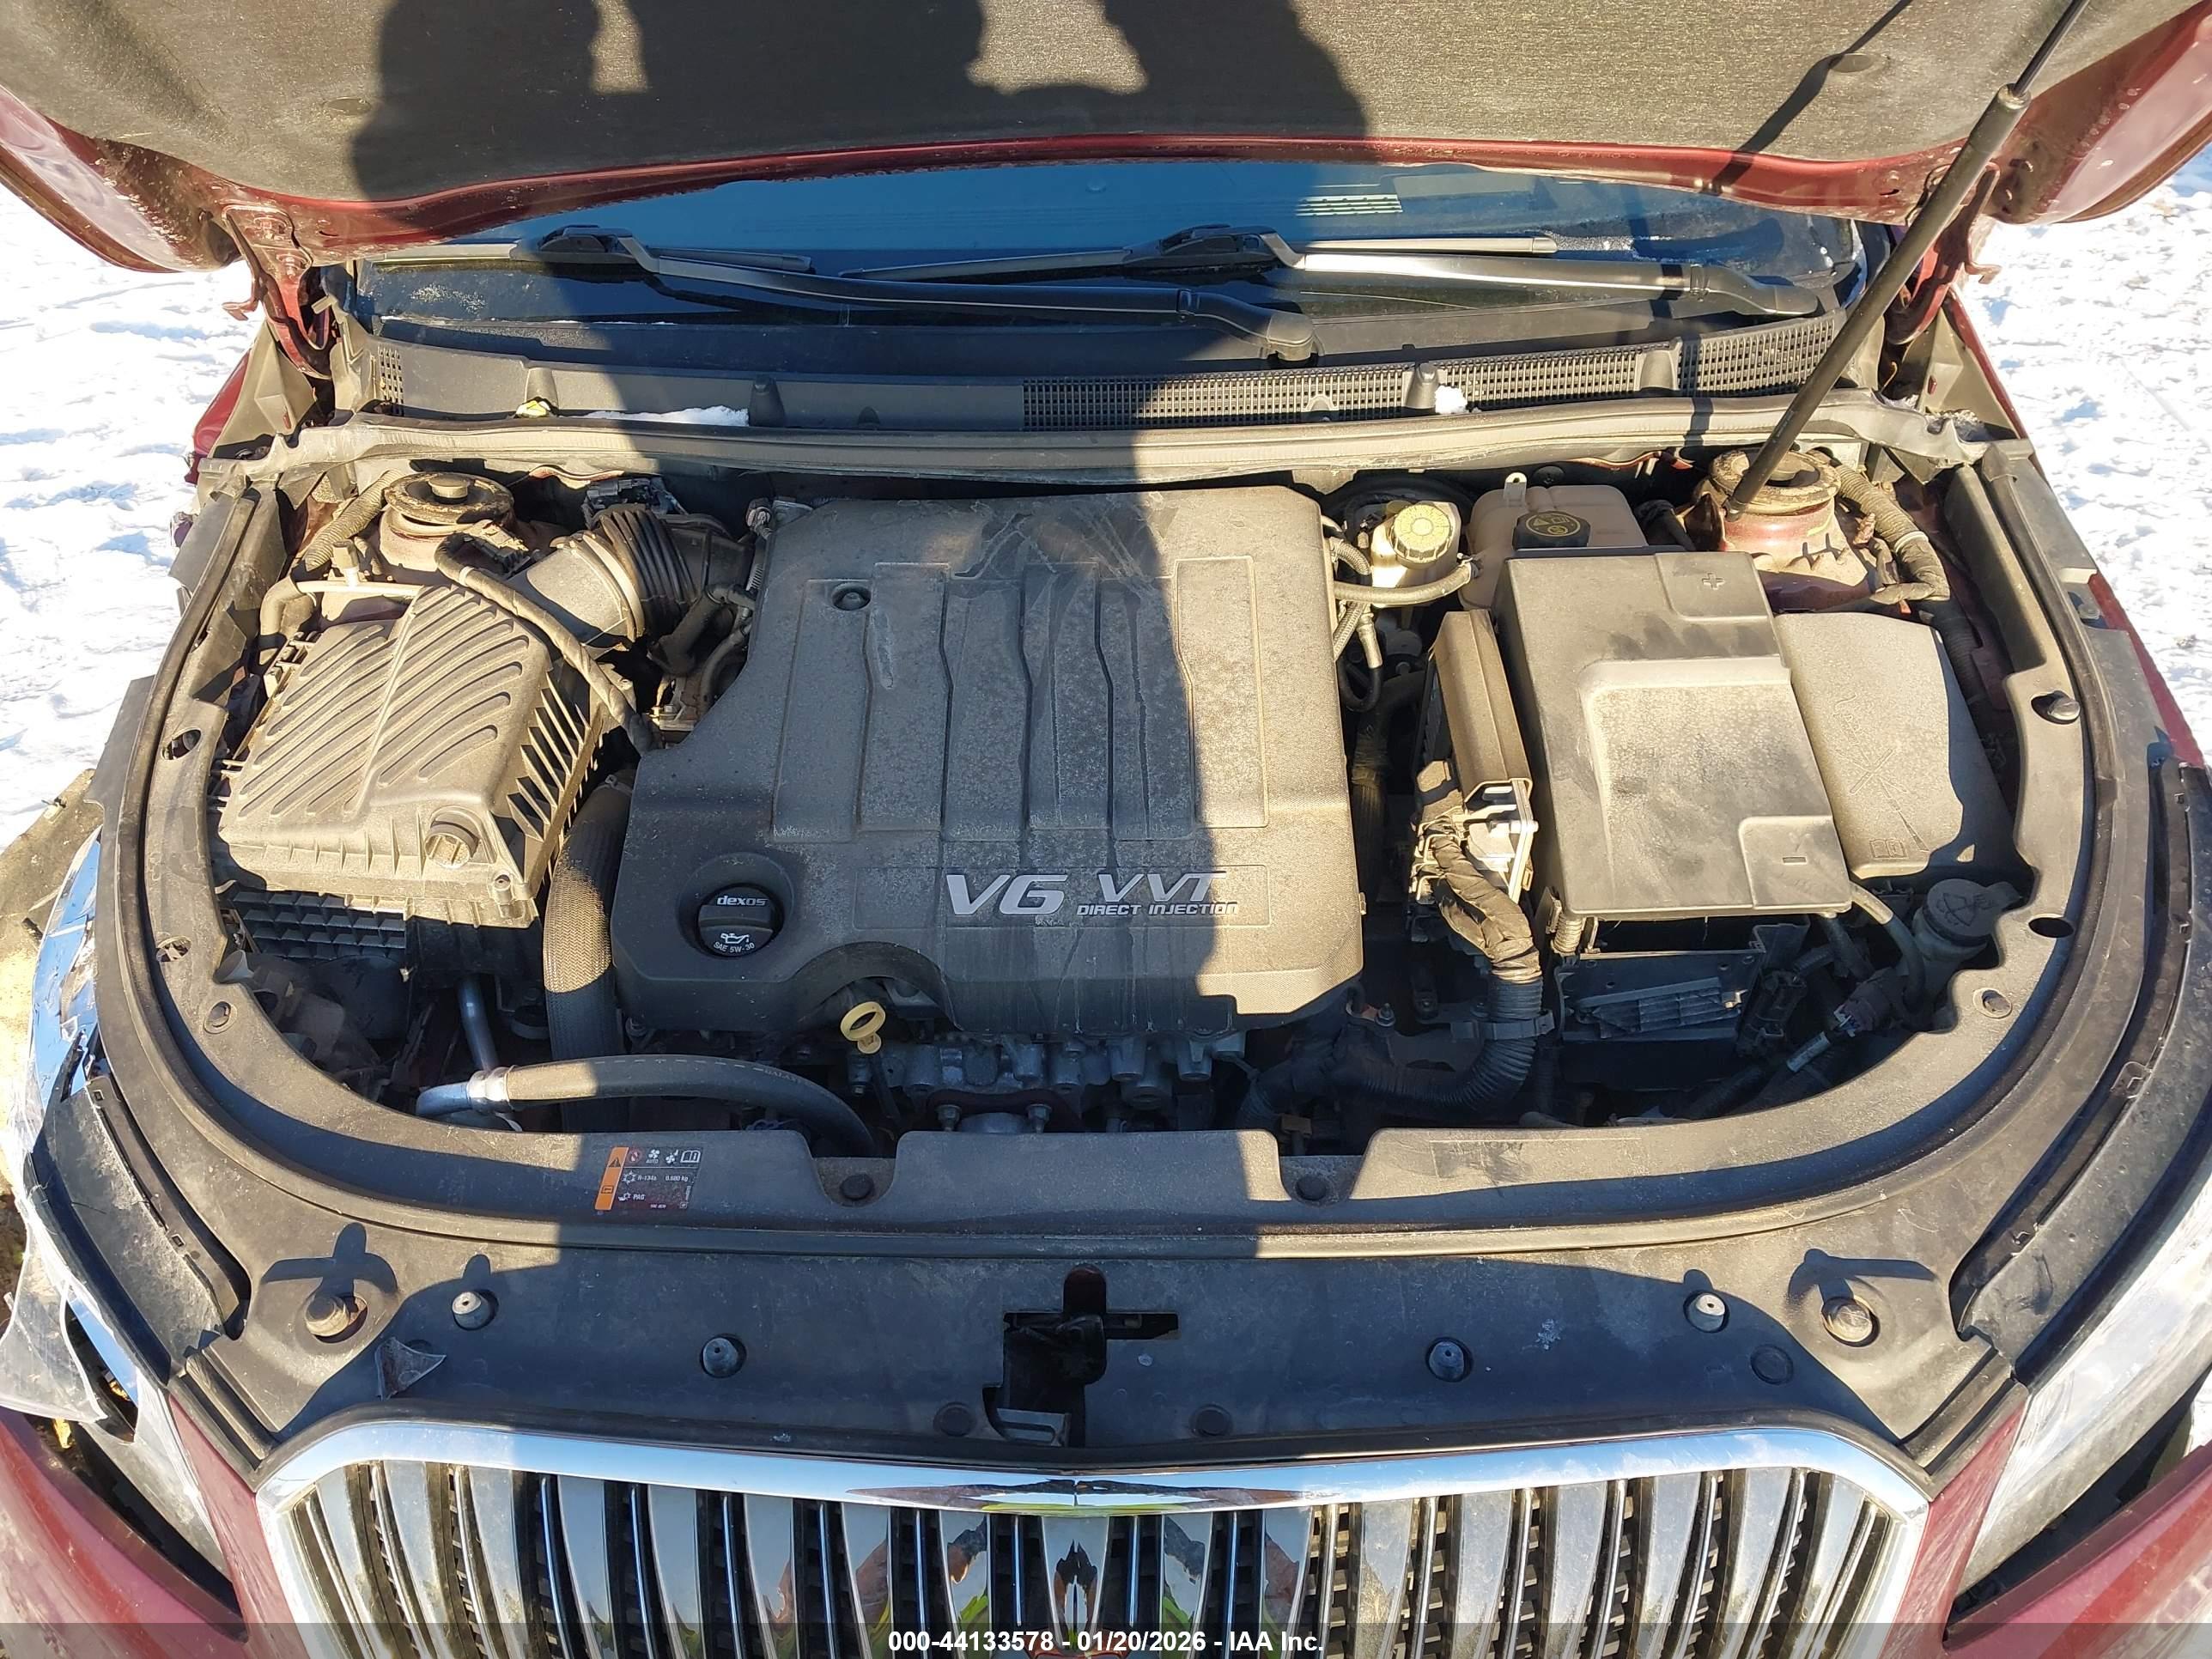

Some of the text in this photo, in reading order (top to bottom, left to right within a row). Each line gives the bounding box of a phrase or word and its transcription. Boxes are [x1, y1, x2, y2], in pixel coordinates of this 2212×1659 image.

[946, 872, 1227, 915] V6 VVT
[715, 895, 769, 907] dexos
[1076, 902, 1238, 915] DIRECT INJECTION
[714, 941, 756, 953] SAE 5W-30
